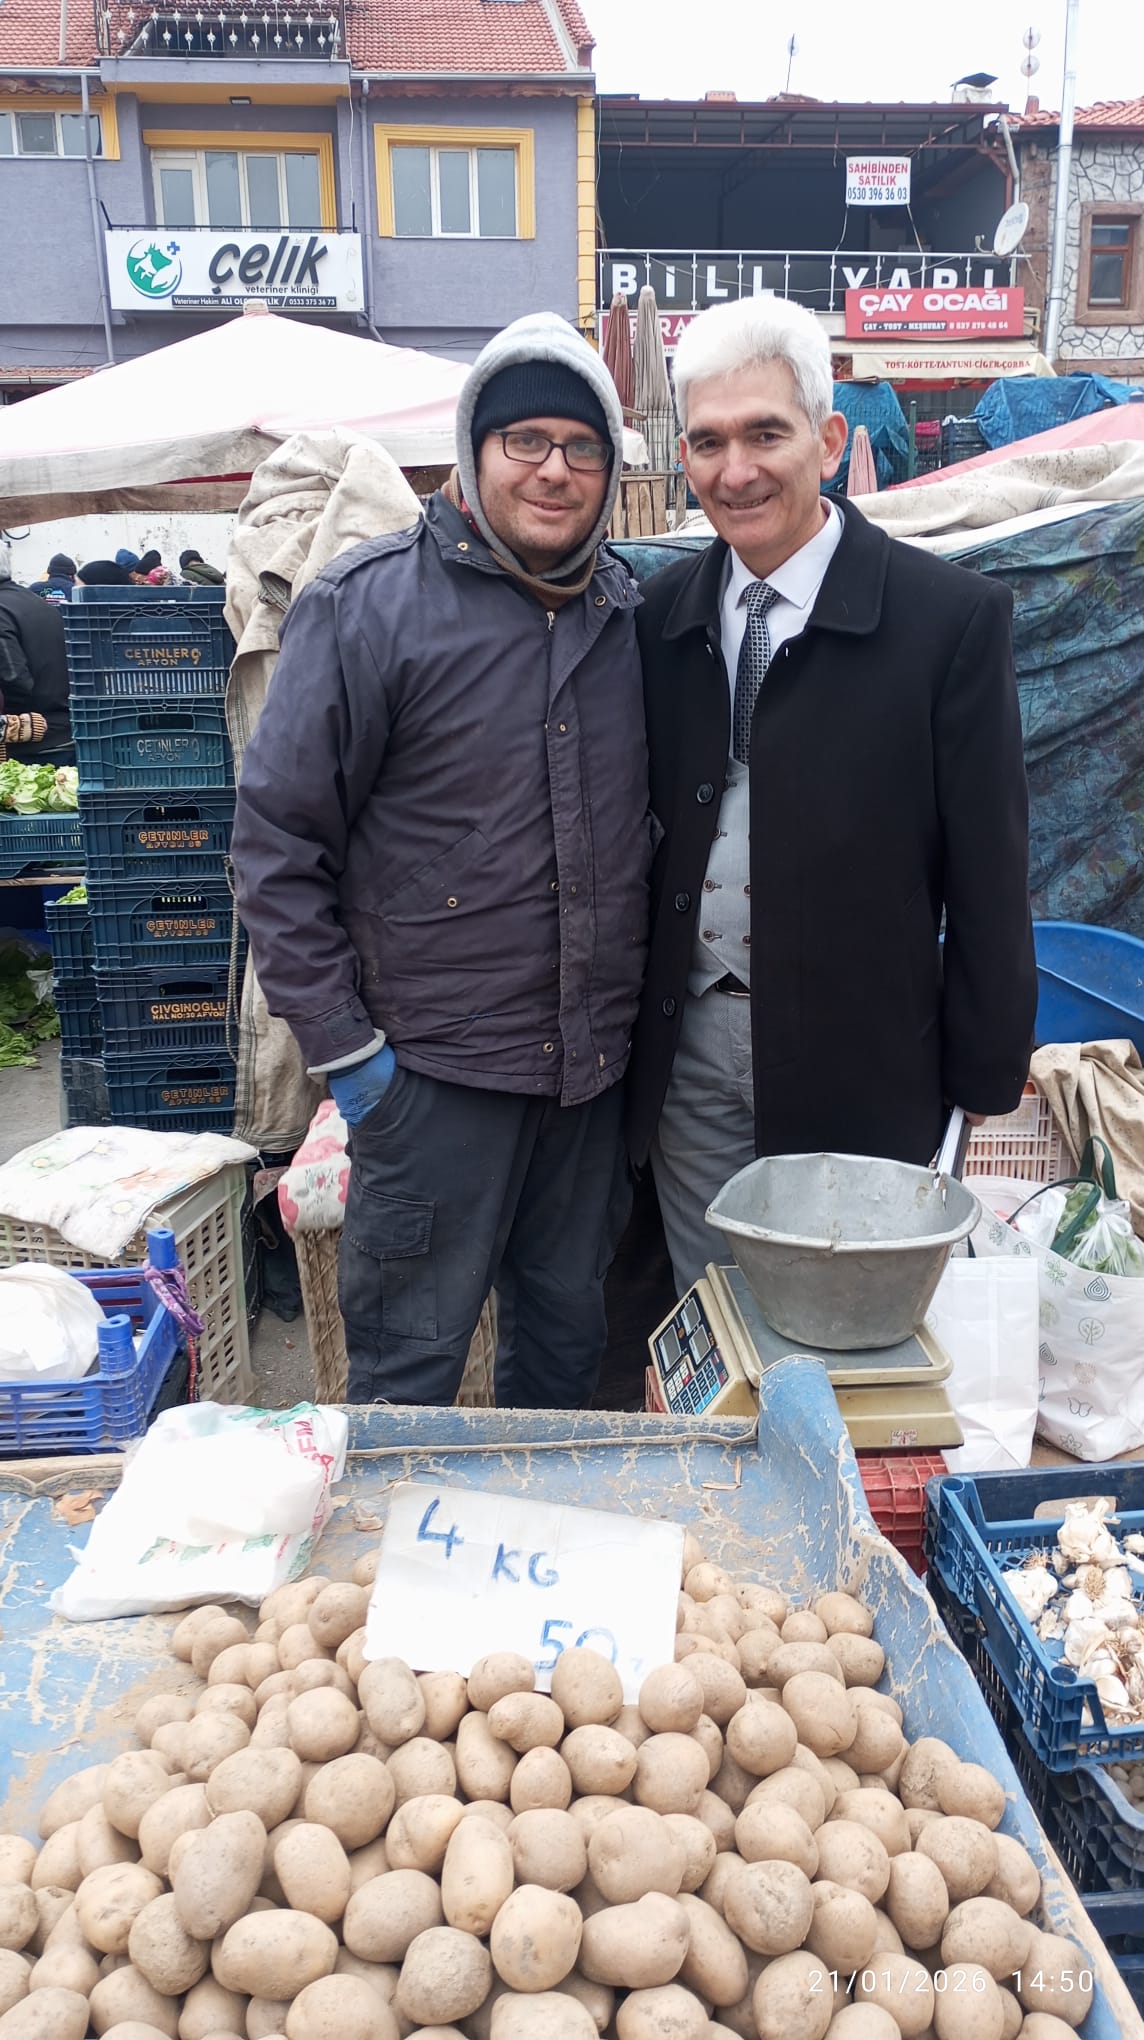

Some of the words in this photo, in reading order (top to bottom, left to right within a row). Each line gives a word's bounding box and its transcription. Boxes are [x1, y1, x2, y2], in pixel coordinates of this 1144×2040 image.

[848, 161, 908, 174] SAHİBİNDEN
[858, 175, 897, 186] SATILIK
[847, 187, 866, 200] 0530
[868, 187, 883, 200] 396
[885, 187, 895, 200] 36
[897, 187, 907, 200] 03
[245, 285, 288, 294] veteriner
[859, 293, 913, 317] ÇAY
[923, 290, 1008, 312] OCAĞI
[863, 322, 878, 332] ÇAY
[416, 1495, 464, 1560] 4
[491, 1542, 560, 1588] KG
